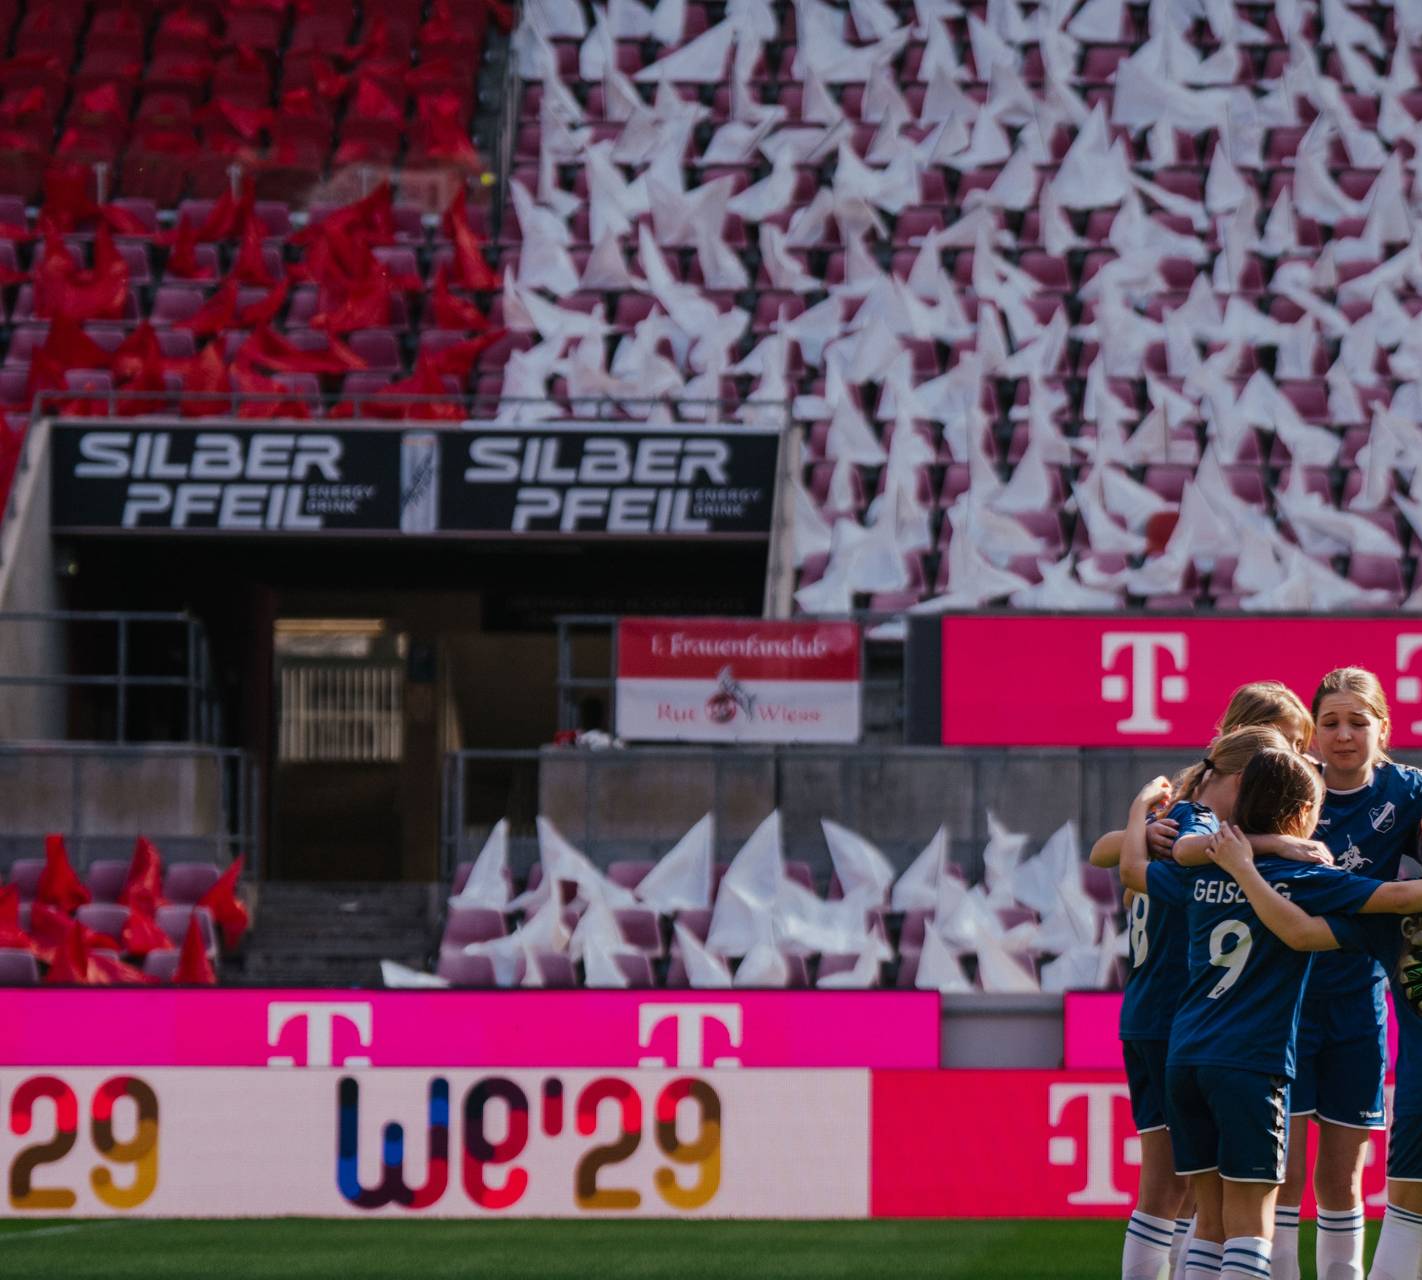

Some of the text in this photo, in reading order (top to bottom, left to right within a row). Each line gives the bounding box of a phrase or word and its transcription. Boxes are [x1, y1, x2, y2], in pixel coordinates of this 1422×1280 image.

[74, 432, 342, 480] SILBER
[464, 437, 730, 484] SILBER
[121, 483, 322, 529] PFEIL
[307, 485, 373, 499] ENERGY
[307, 500, 357, 514] DRINK
[511, 487, 710, 533] PFEIL
[693, 502, 745, 517] DRINK
[694, 488, 761, 501] ENERGY
[671, 632, 828, 657] Frauenfanclub
[1207, 919, 1253, 999] 9
[8, 1074, 160, 1210] 29
